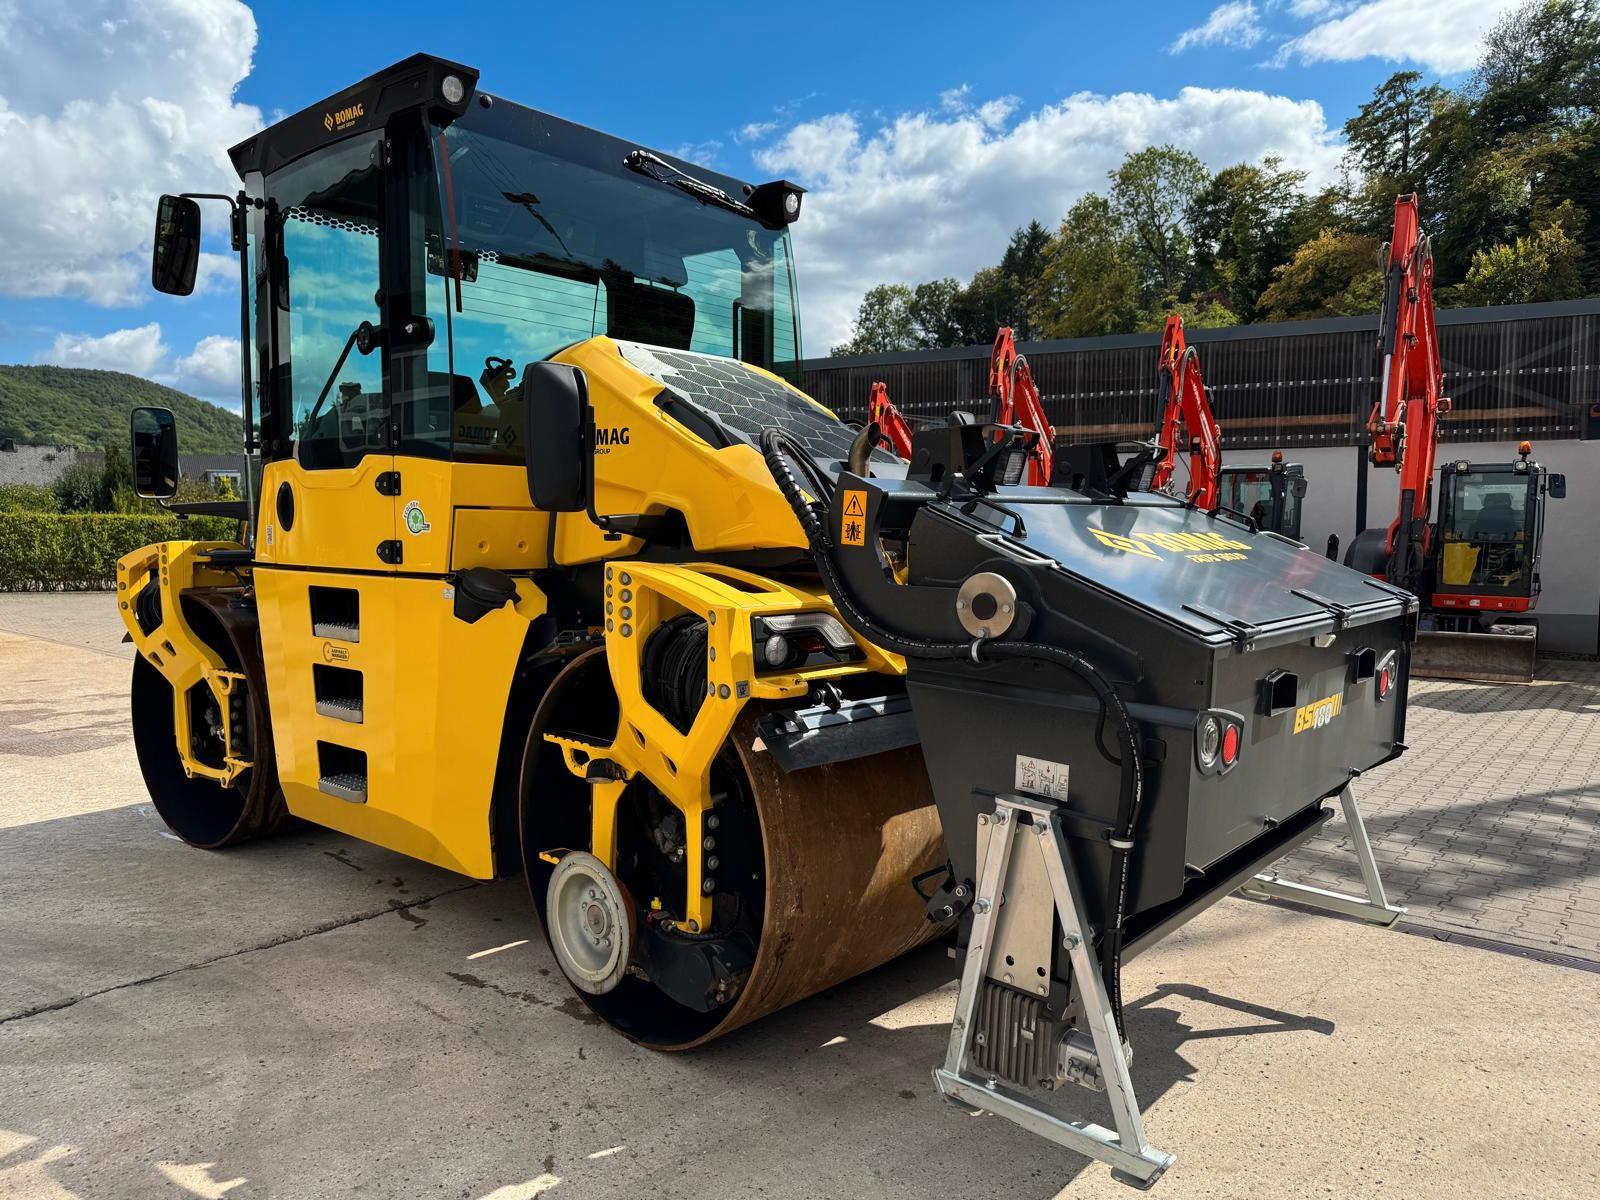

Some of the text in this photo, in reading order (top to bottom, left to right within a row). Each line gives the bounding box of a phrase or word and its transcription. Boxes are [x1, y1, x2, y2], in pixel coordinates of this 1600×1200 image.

[335, 104, 364, 124] BOMAG
[596, 427, 630, 446] MAG
[1132, 532, 1253, 552] BOMAG
